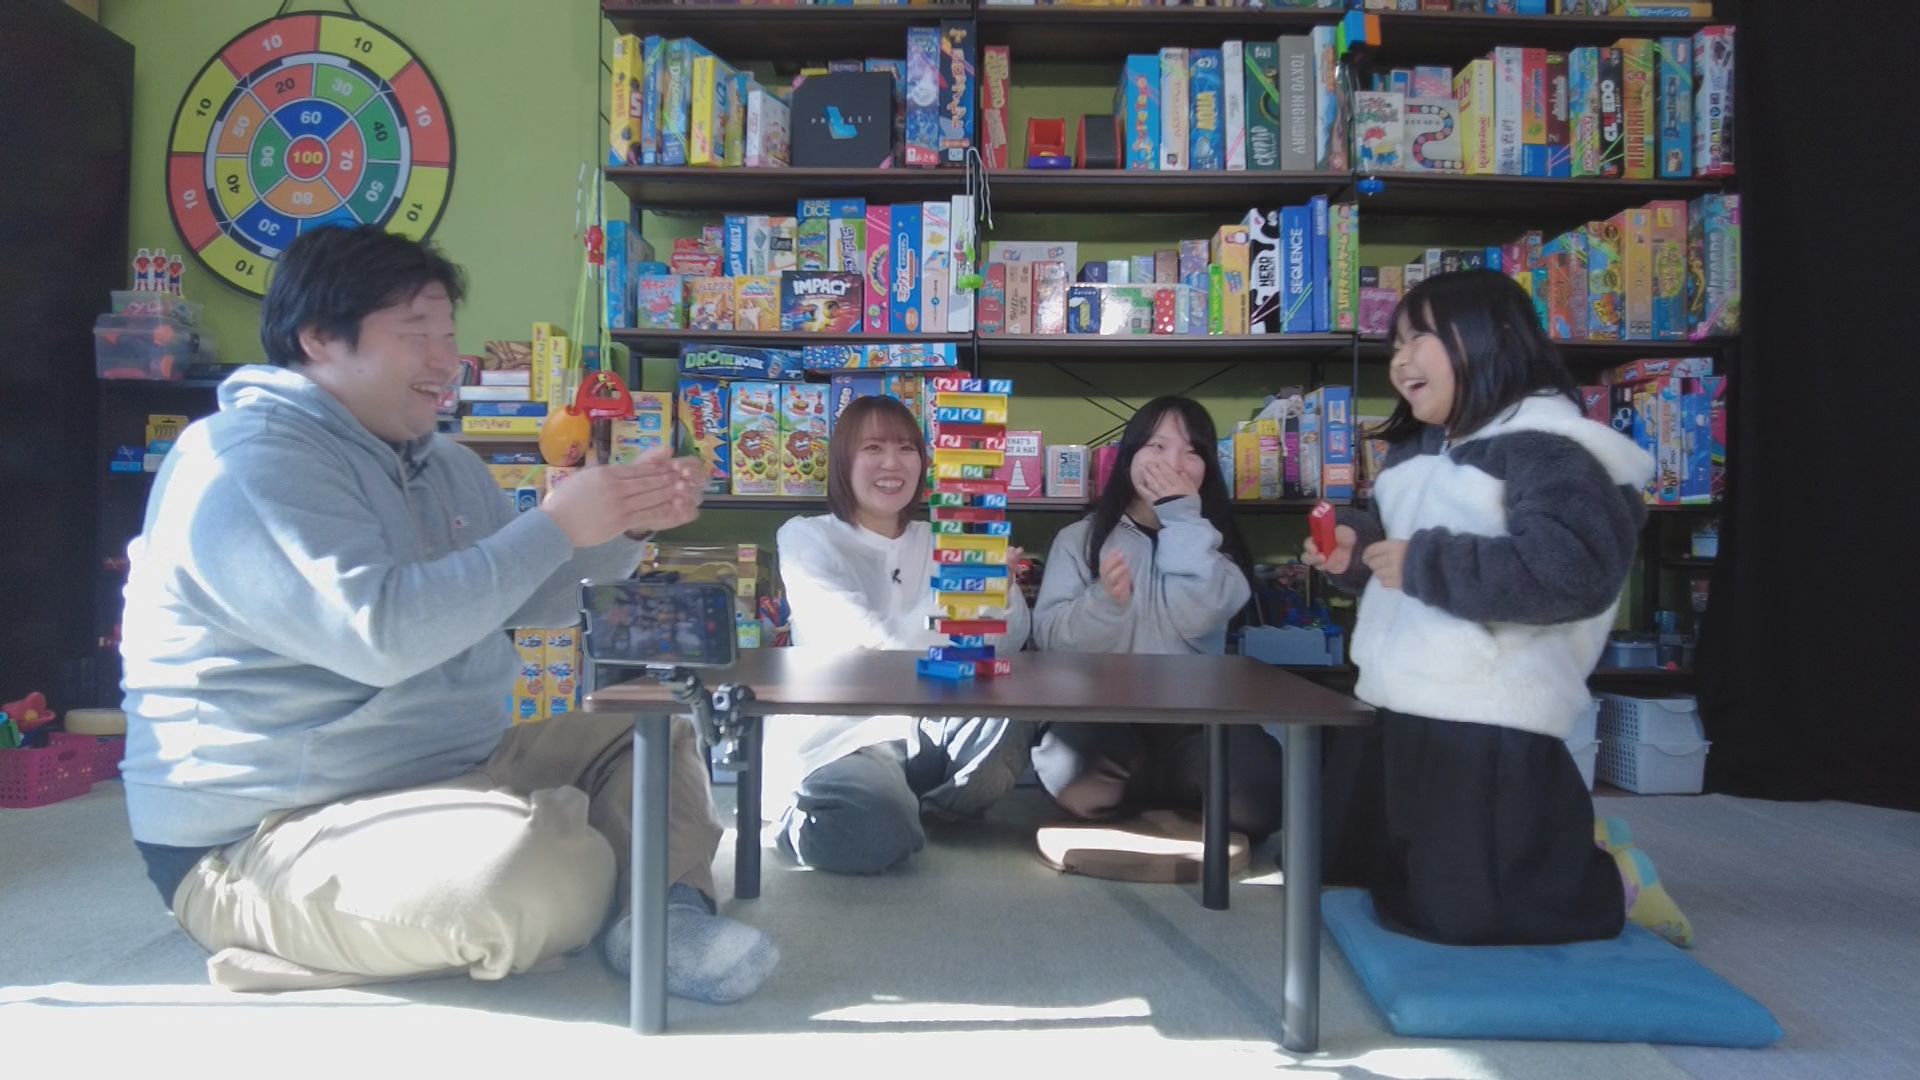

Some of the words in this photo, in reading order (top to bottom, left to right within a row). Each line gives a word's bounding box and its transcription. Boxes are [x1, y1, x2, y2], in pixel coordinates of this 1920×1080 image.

[262, 34, 282, 51] 10
[353, 37, 373, 54] 10
[1290, 53, 1305, 92] TOKYO
[275, 78, 296, 95] 20
[331, 78, 353, 97] 30
[196, 98, 212, 117] 10
[300, 111, 322, 124] 60
[415, 105, 432, 127] 10
[373, 121, 388, 142] 40
[1290, 95, 1306, 154] HIGHWAY
[1251, 125, 1274, 166] CRYPTID
[1582, 116, 1594, 172] MONOPOLY
[292, 152, 323, 164] 100
[340, 149, 354, 170] 70
[226, 174, 240, 194] 40
[366, 180, 384, 202] 50
[183, 189, 197, 209] 10
[406, 202, 423, 222] 10
[803, 206, 831, 217] DICE
[258, 218, 280, 236] 30
[235, 260, 254, 276] 10
[1290, 228, 1304, 294] SEQUENCE
[1259, 256, 1270, 287] HERD
[793, 279, 851, 296] IMPACT
